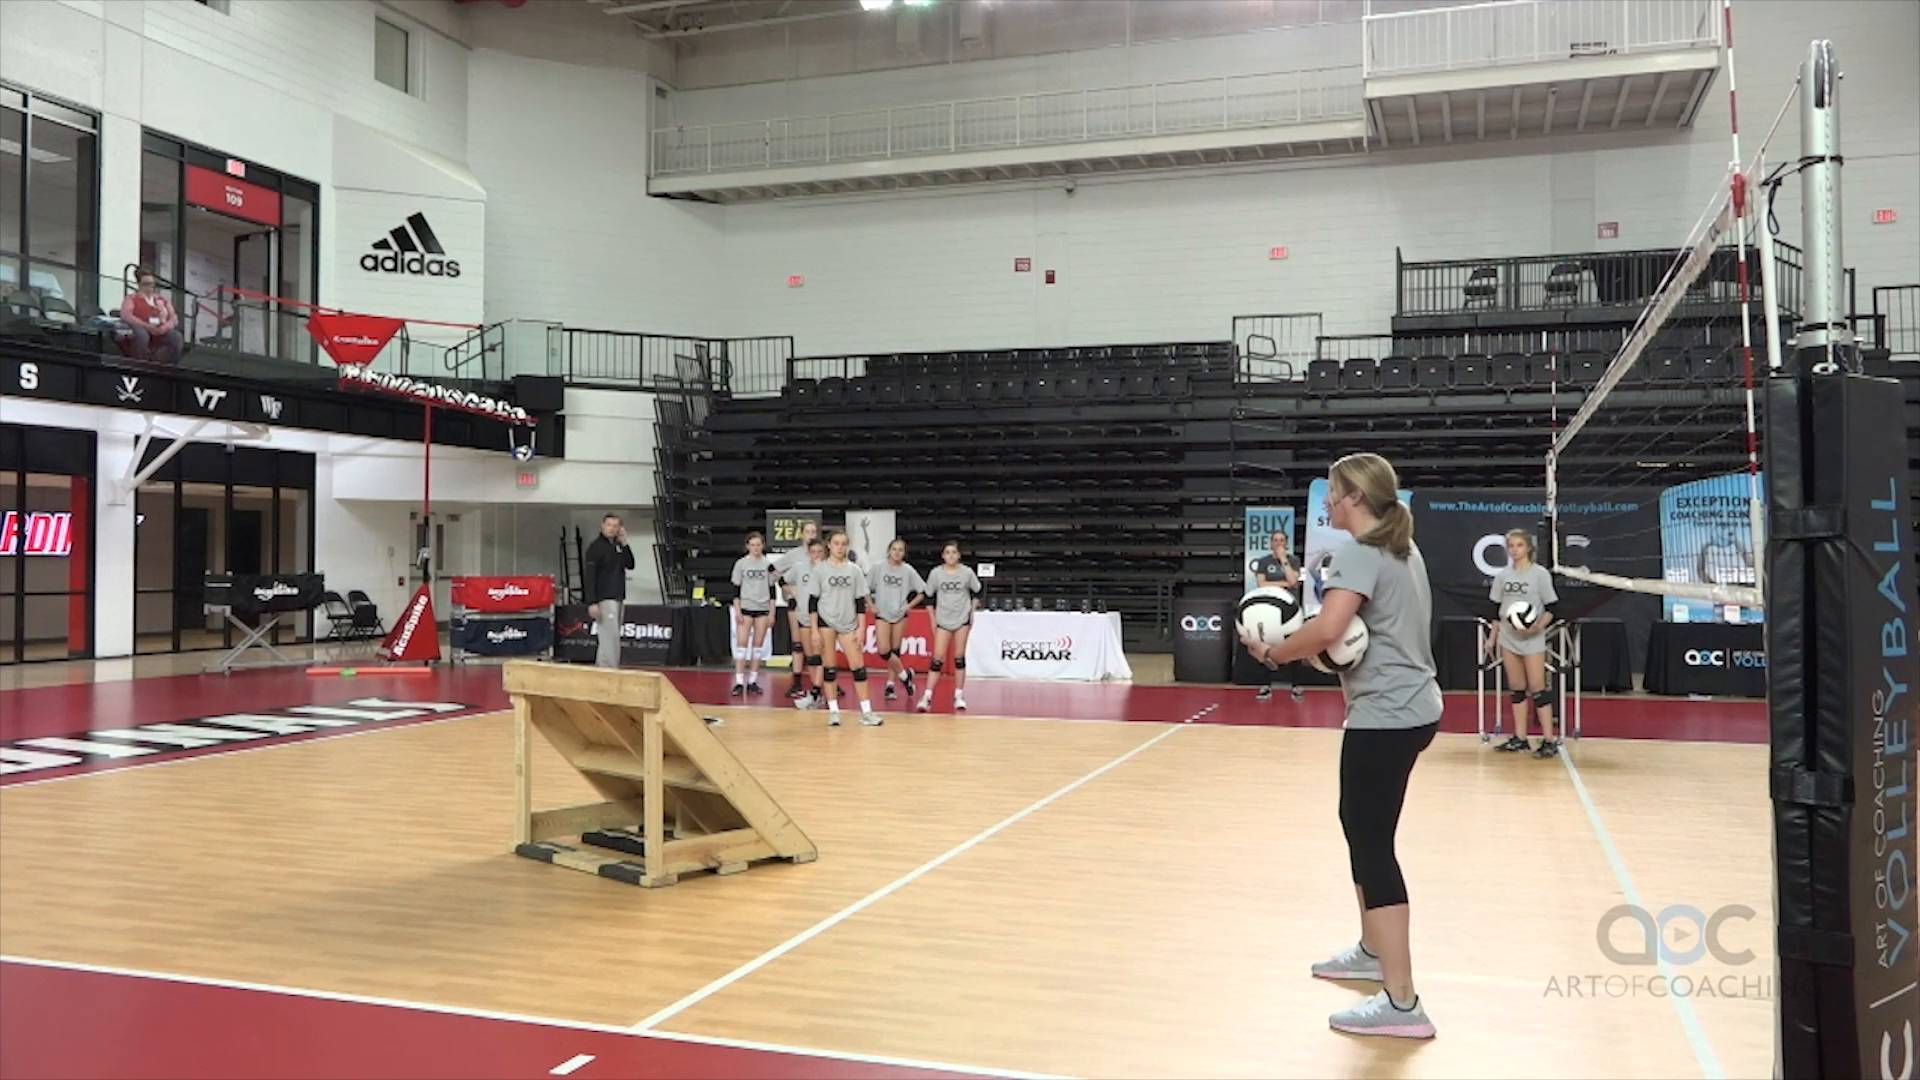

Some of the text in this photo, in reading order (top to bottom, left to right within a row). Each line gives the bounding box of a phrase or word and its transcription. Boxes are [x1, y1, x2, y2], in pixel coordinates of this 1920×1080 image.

[360, 251, 461, 278] adidas
[20, 363, 39, 389] S
[194, 387, 227, 411] VT
[1249, 515, 1289, 534] BUY
[1001, 640, 1055, 650] POCKET
[1001, 649, 1071, 661] RADAR
[1871, 477, 1909, 967] VOLLEYBALL
[1872, 688, 1890, 969] ART OF COACHING
